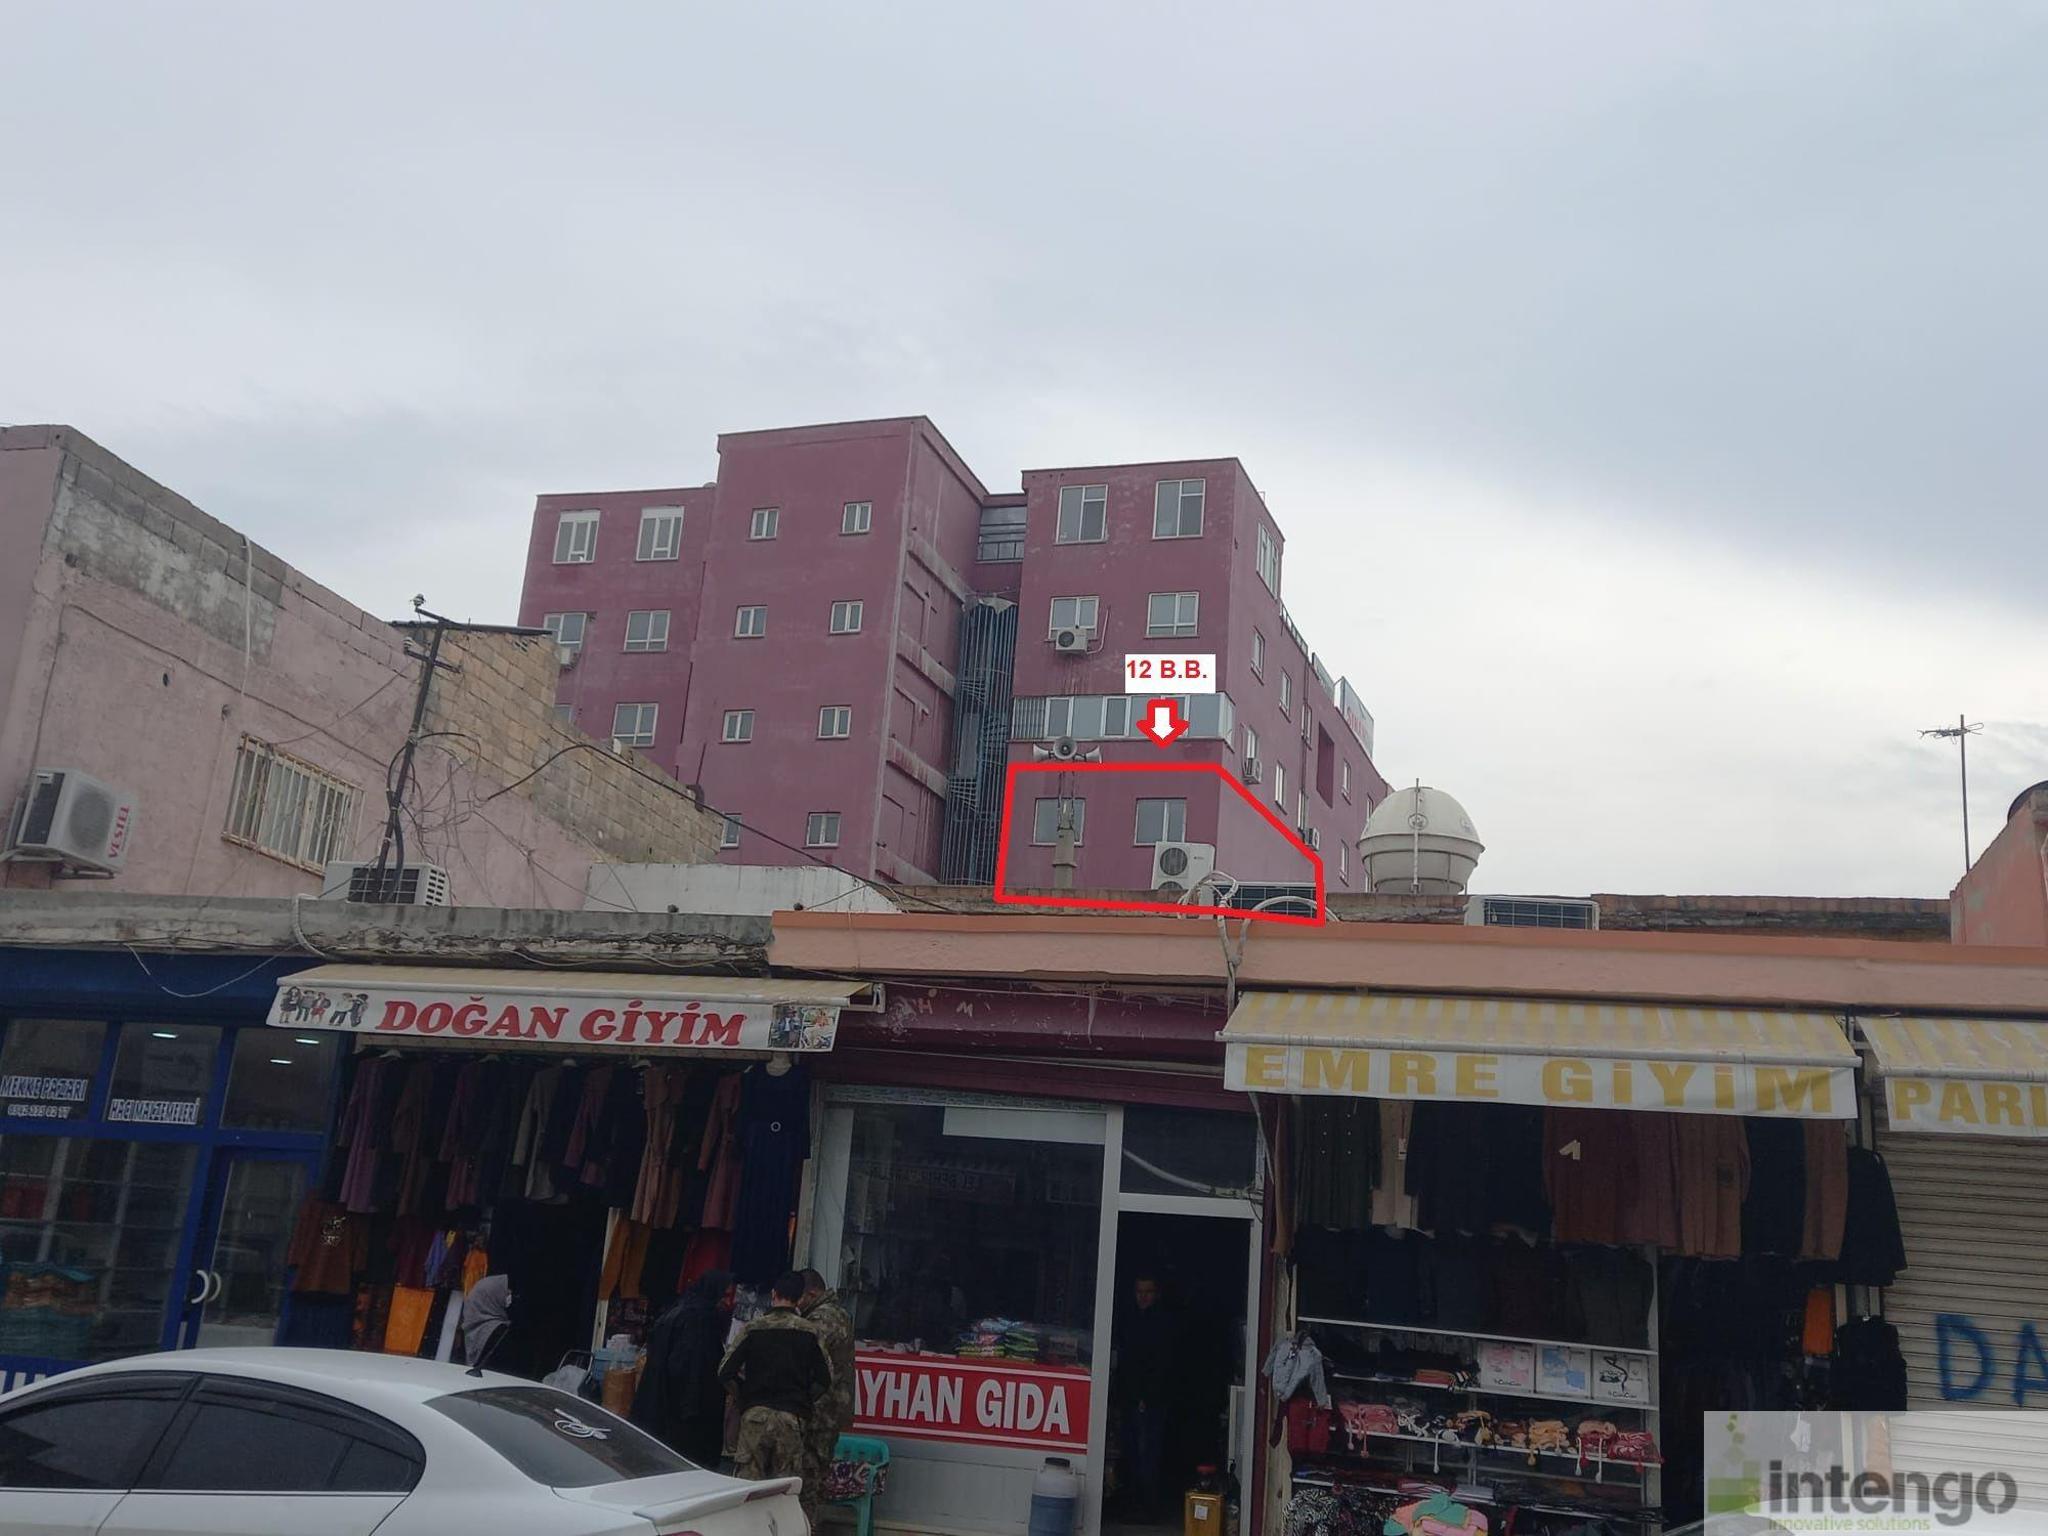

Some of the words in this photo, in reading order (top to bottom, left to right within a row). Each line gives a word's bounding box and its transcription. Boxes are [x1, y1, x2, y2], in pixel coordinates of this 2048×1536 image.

[375, 995, 569, 1039] DOĞAN
[579, 1000, 748, 1046] GİYİM
[0, 1075, 42, 1100] MEKKE
[40, 1077, 89, 1102] PAZARI
[1245, 1046, 1499, 1097] EMRE
[975, 1379, 1071, 1435] GIDA
